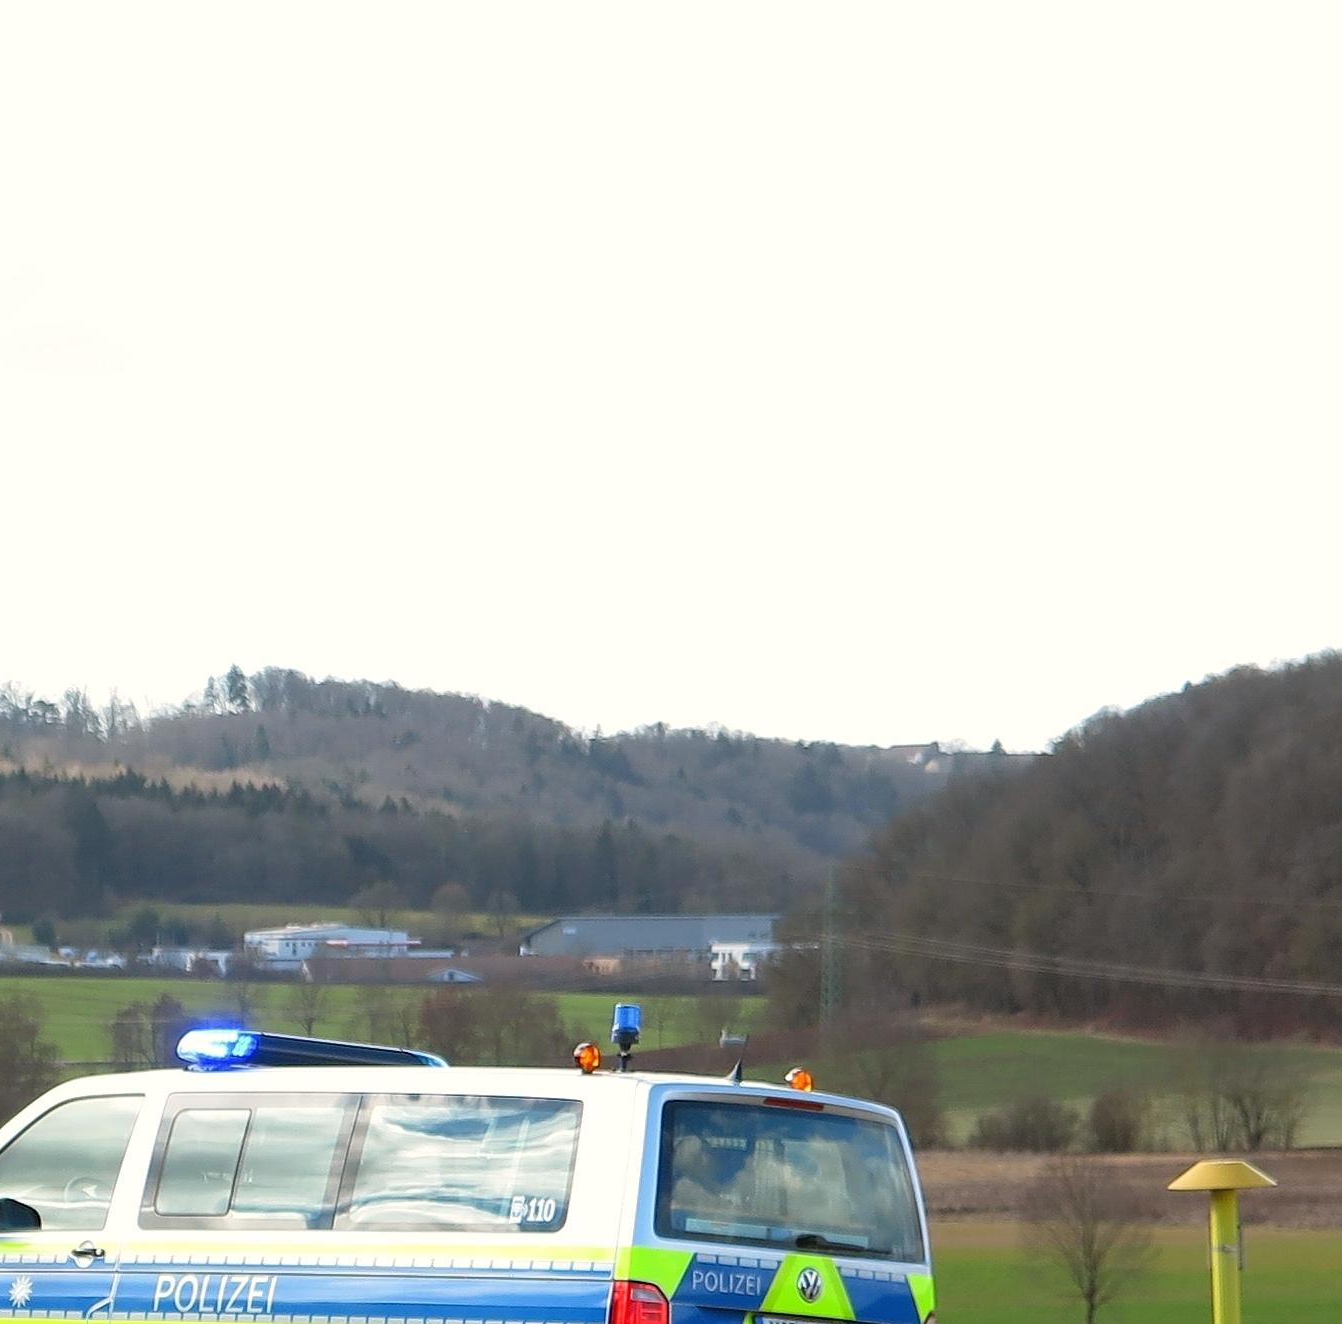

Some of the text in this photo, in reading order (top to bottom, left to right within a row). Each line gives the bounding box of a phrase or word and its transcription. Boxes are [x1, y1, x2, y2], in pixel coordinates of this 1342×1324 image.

[526, 1198, 556, 1222] 110
[153, 1273, 277, 1314] POLIZEI
[691, 1270, 762, 1296] POLIZEI
